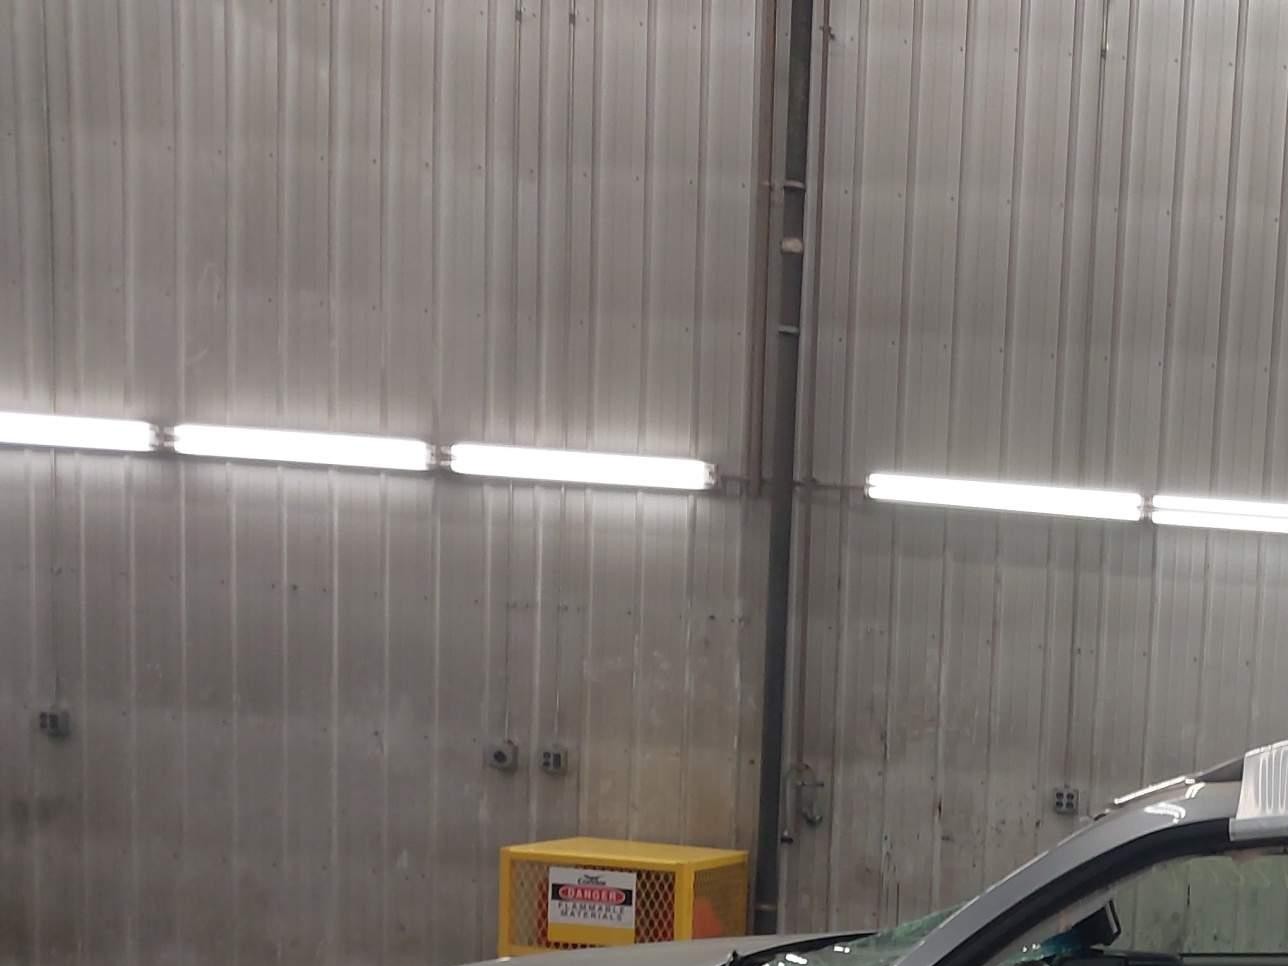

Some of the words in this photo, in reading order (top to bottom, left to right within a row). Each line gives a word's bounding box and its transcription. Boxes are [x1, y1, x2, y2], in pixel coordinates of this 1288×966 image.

[567, 887, 617, 902] DANGER
[558, 901, 625, 914] FLAMMABLE
[560, 909, 622, 921] MATERIALS
